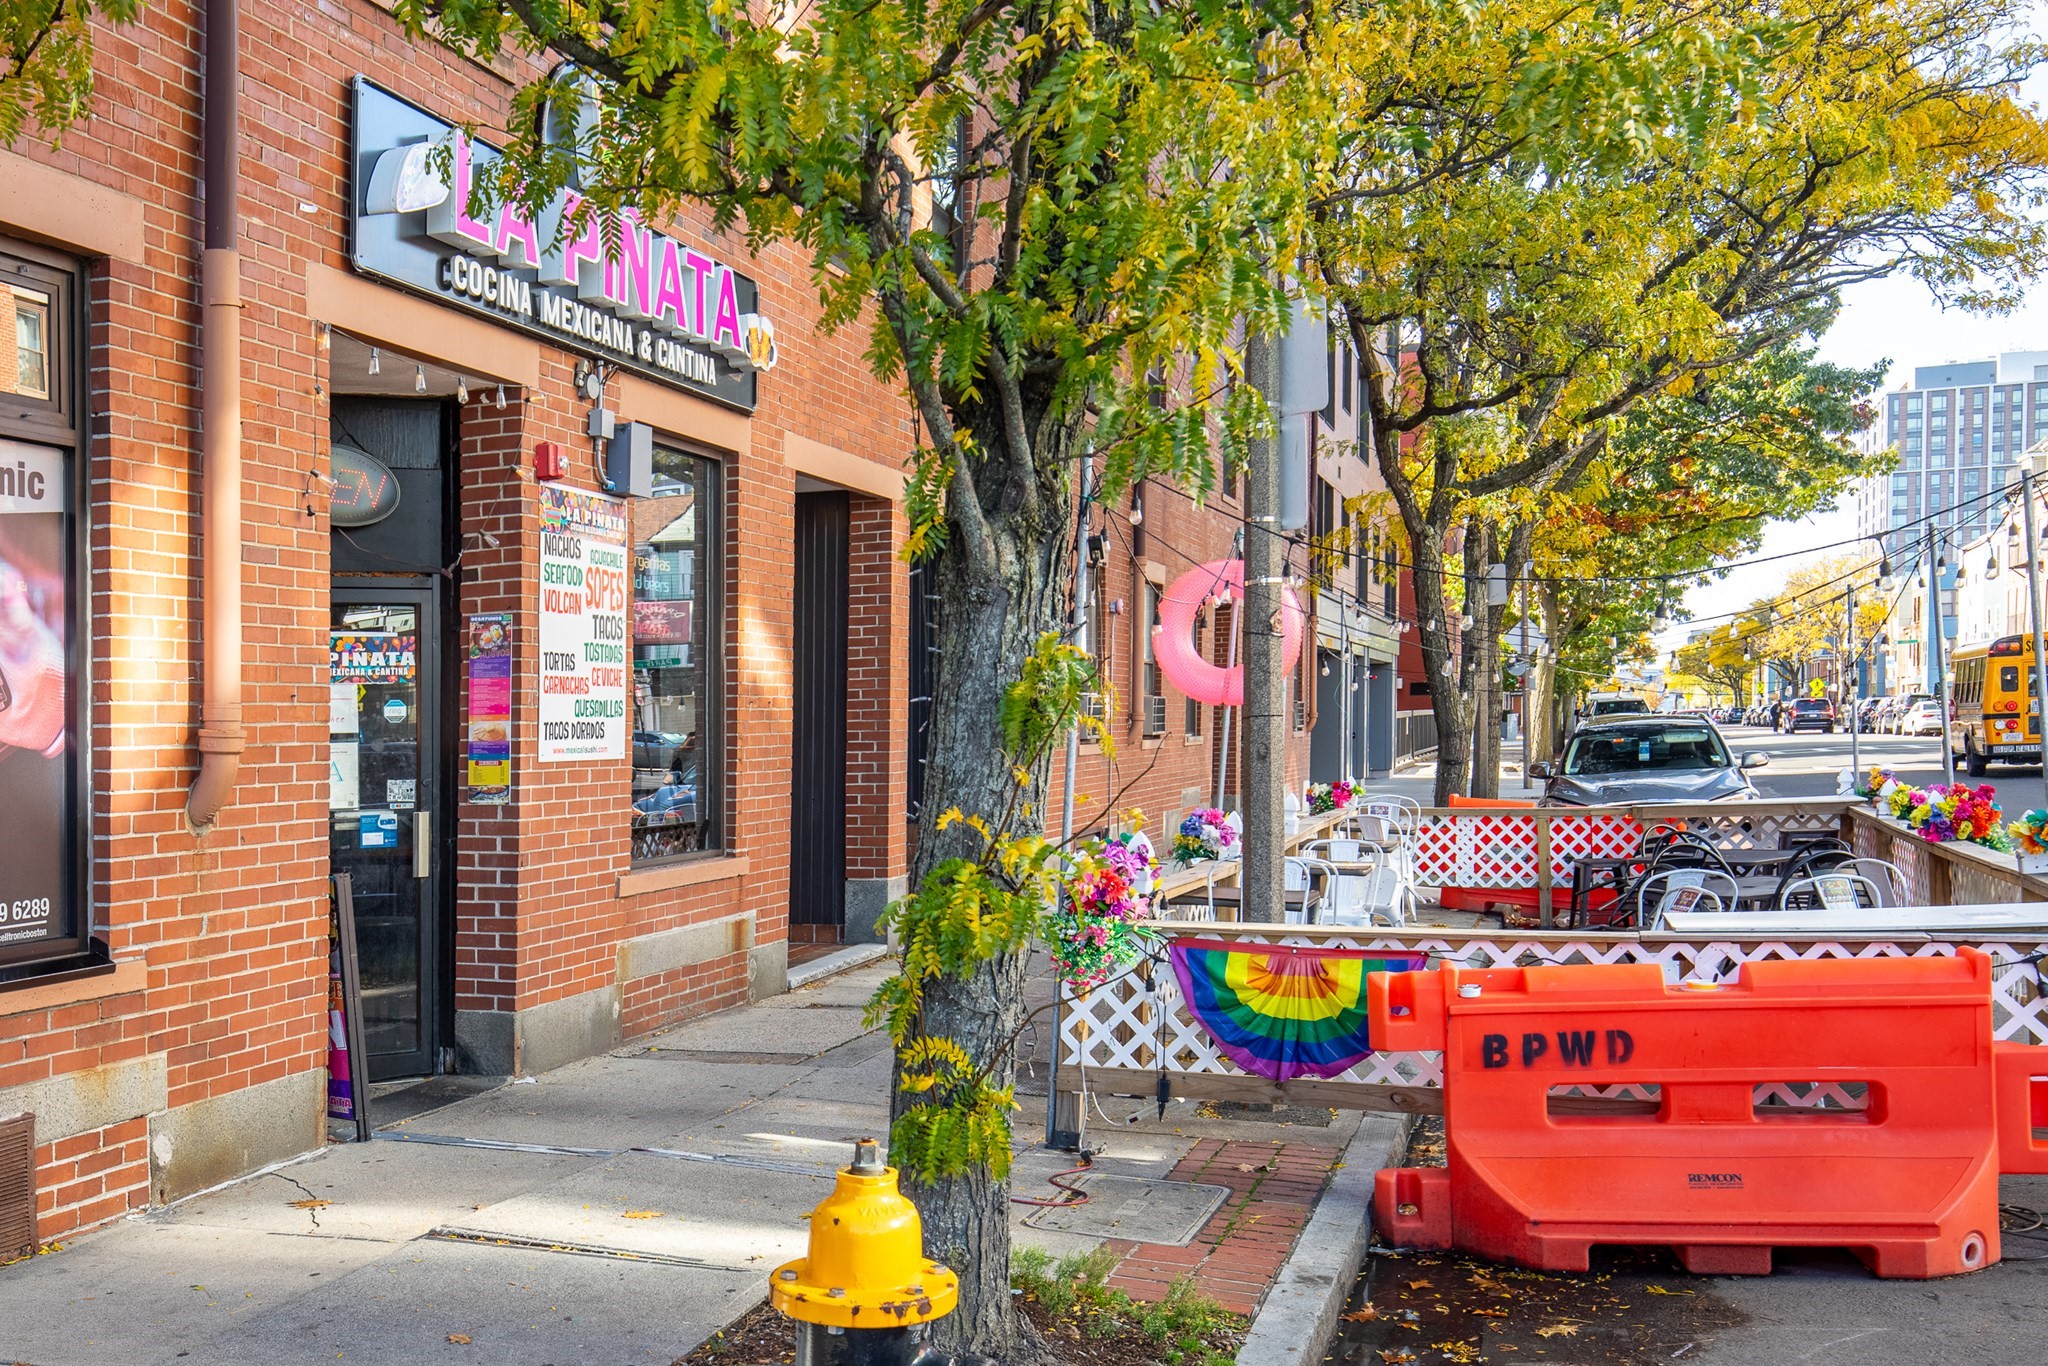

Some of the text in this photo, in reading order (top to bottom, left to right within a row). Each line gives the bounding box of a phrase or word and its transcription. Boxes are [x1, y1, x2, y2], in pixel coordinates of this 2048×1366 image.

[455, 128, 744, 350] LA PIÑATA
[452, 255, 717, 387] COCINA MEXICANA & CANTINA
[0, 461, 45, 500] nic
[566, 506, 581, 523] LA
[544, 533, 582, 559] NACHOS
[544, 562, 583, 587] SEAFOOD
[585, 566, 624, 612] SOPES
[544, 588, 582, 615] VOLCAN
[592, 614, 624, 640] TACOS
[330, 647, 416, 667] PIÑATA
[543, 651, 576, 672] TORTAS
[584, 642, 624, 663] TOSTADAS
[375, 667, 409, 677] CANTINA
[591, 667, 624, 688] CEVICHE
[574, 698, 624, 718] QUESADILLAS
[543, 721, 605, 741] TACOS DORADOS
[12, 897, 50, 921] 6289
[1688, 1173, 1743, 1183] REMCON
